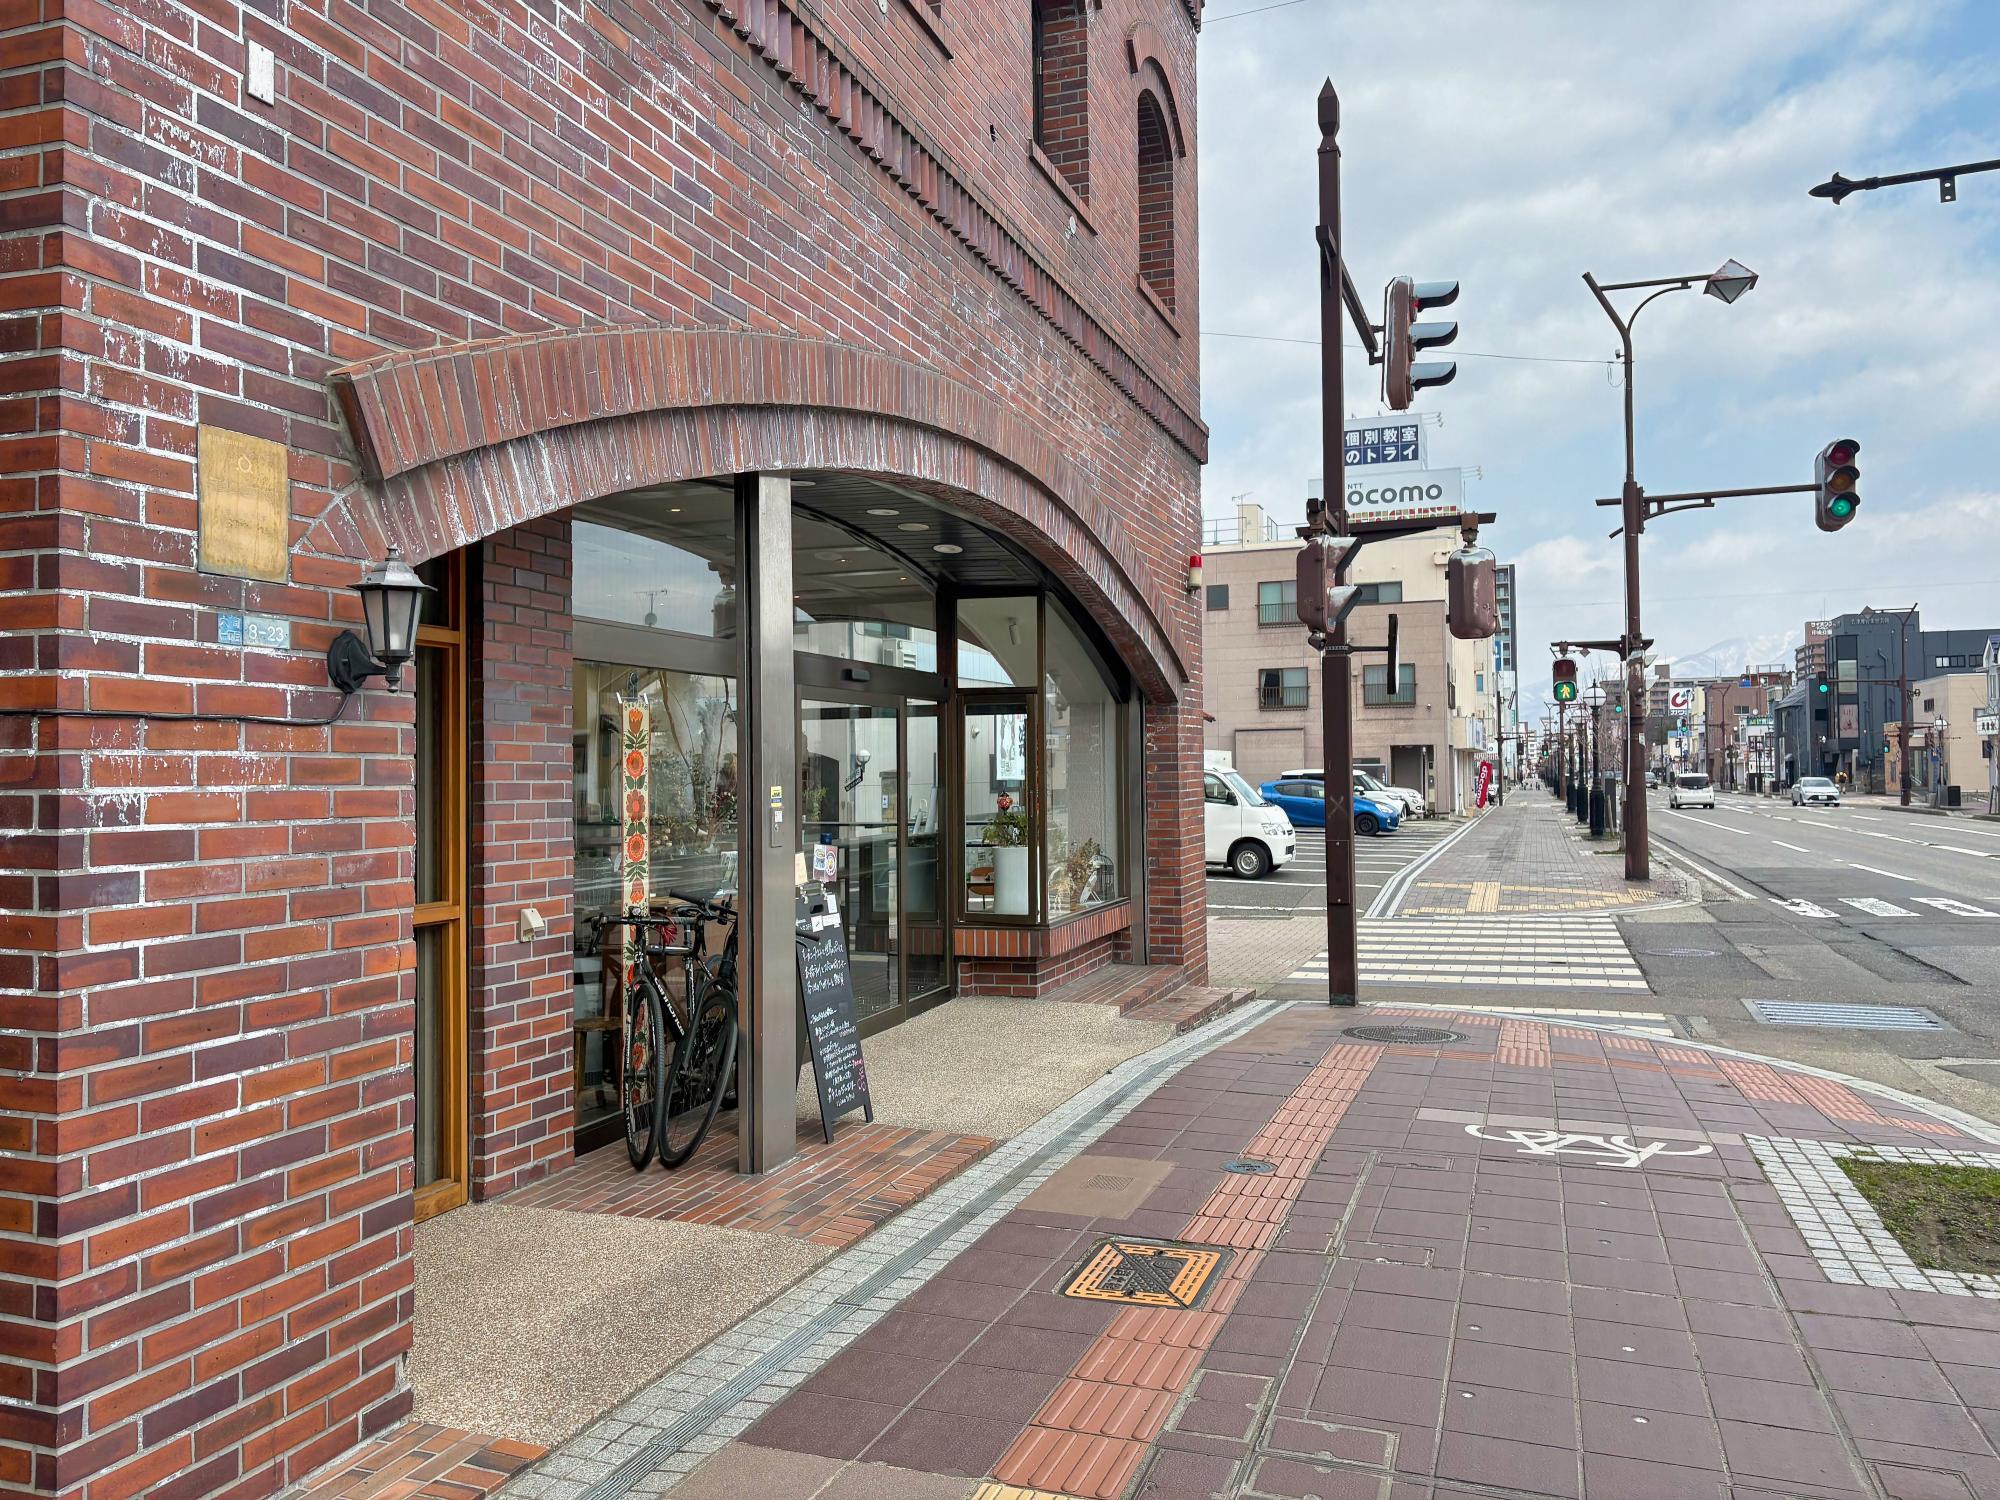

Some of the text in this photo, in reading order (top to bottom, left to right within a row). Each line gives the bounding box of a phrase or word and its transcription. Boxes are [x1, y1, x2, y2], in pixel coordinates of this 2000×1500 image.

[1345, 427, 1417, 446] 個別教室
[1345, 444, 1416, 463] のトライ
[1347, 483, 1363, 491] NTT
[1347, 484, 1443, 506] ocomo
[248, 623, 284, 642] 8-23
